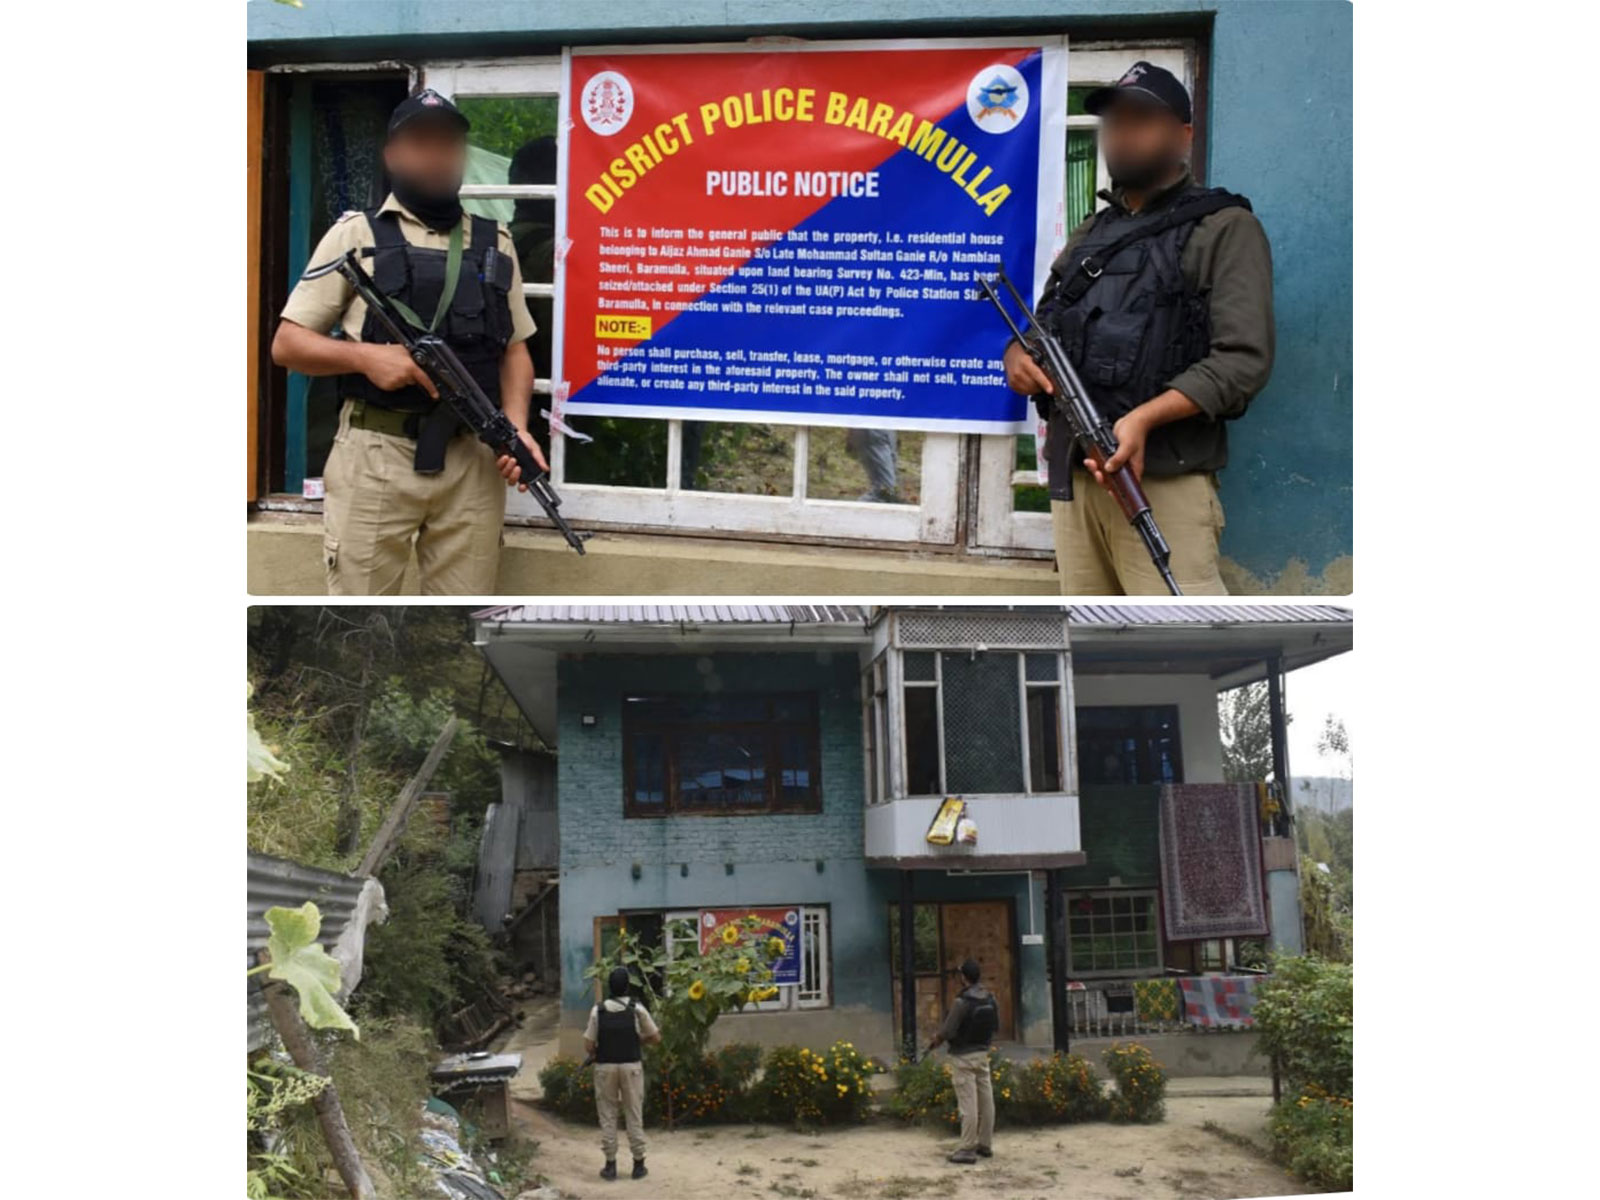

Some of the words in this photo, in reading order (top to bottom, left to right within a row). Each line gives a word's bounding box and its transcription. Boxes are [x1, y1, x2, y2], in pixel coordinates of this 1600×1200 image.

[585, 112, 694, 214] DISRICT
[700, 88, 815, 136] POLICE
[825, 91, 1012, 217] BARAMULLA
[706, 171, 787, 197] PUBLIC
[794, 171, 880, 197] NOTICE
[600, 227, 619, 238] This
[624, 228, 632, 238] is
[637, 228, 646, 239] to
[652, 228, 683, 239] inform
[688, 229, 704, 240] the
[708, 230, 746, 241] general
[751, 230, 783, 241] public
[787, 231, 808, 242] that
[812, 231, 829, 242] the
[834, 232, 882, 244] property,
[908, 233, 966, 244] residential
[970, 234, 1003, 245] house
[599, 245, 645, 258] belonging
[649, 246, 657, 257] to
[687, 246, 720, 258] Ahmad
[723, 247, 751, 258] Ganie
[754, 248, 770, 259] S/o
[773, 248, 794, 260] Late
[797, 249, 857, 261] Mohammad
[860, 250, 893, 261] Sultan
[896, 250, 925, 262] Ganie
[929, 251, 948, 263] R/o
[952, 252, 1000, 263] Nambian
[694, 265, 734, 276] situated
[738, 268, 763, 278] upon
[768, 266, 789, 277] land
[794, 267, 832, 280] bearing
[837, 268, 872, 281] Survey
[877, 269, 894, 280] No.
[900, 269, 947, 282] 423-Min,
[950, 270, 969, 281] has
[599, 281, 673, 293] seized/attached
[677, 283, 705, 293] under
[709, 283, 747, 294] Section
[752, 284, 778, 296] 25(1)
[782, 285, 792, 296] of
[795, 285, 811, 297] the
[815, 286, 844, 298] UA(P)
[847, 286, 864, 298] Act
[869, 287, 880, 299] by
[886, 287, 918, 299] Police
[922, 288, 959, 300] Station
[652, 300, 662, 310] in
[664, 301, 718, 312] connection
[722, 302, 743, 313] with
[746, 303, 761, 313] the
[765, 304, 805, 315] relevant
[809, 306, 833, 315] case
[836, 306, 904, 319] proceedings.
[599, 320, 647, 334] NOTE:-
[597, 346, 610, 356] No
[613, 348, 644, 357] person
[648, 348, 671, 358] shall
[674, 349, 722, 361] purchase,
[726, 350, 746, 362] sell,
[750, 351, 790, 364] transfer,
[794, 352, 823, 364] lease,
[827, 355, 878, 367] mortgage,
[881, 357, 892, 366] or
[895, 356, 946, 368] otherwise
[950, 359, 983, 369] create
[597, 361, 646, 373] third-party
[651, 363, 688, 374] interest
[692, 365, 701, 374] in
[705, 365, 721, 375] the
[726, 366, 771, 377] aforesaid
[775, 369, 819, 381] property.
[825, 369, 843, 380] The
[847, 372, 879, 381] owner
[884, 371, 909, 382] shall
[913, 373, 930, 383] not
[935, 373, 957, 385] sell,
[962, 375, 1006, 387] transfer,
[597, 376, 638, 387] alienate,
[641, 380, 651, 388] or
[654, 379, 685, 390] create
[687, 381, 704, 392] any
[708, 381, 759, 394] third-party
[762, 383, 800, 395] interest
[803, 384, 812, 395] in
[815, 385, 831, 396] the
[834, 386, 855, 397] said
[859, 388, 905, 400] property.
